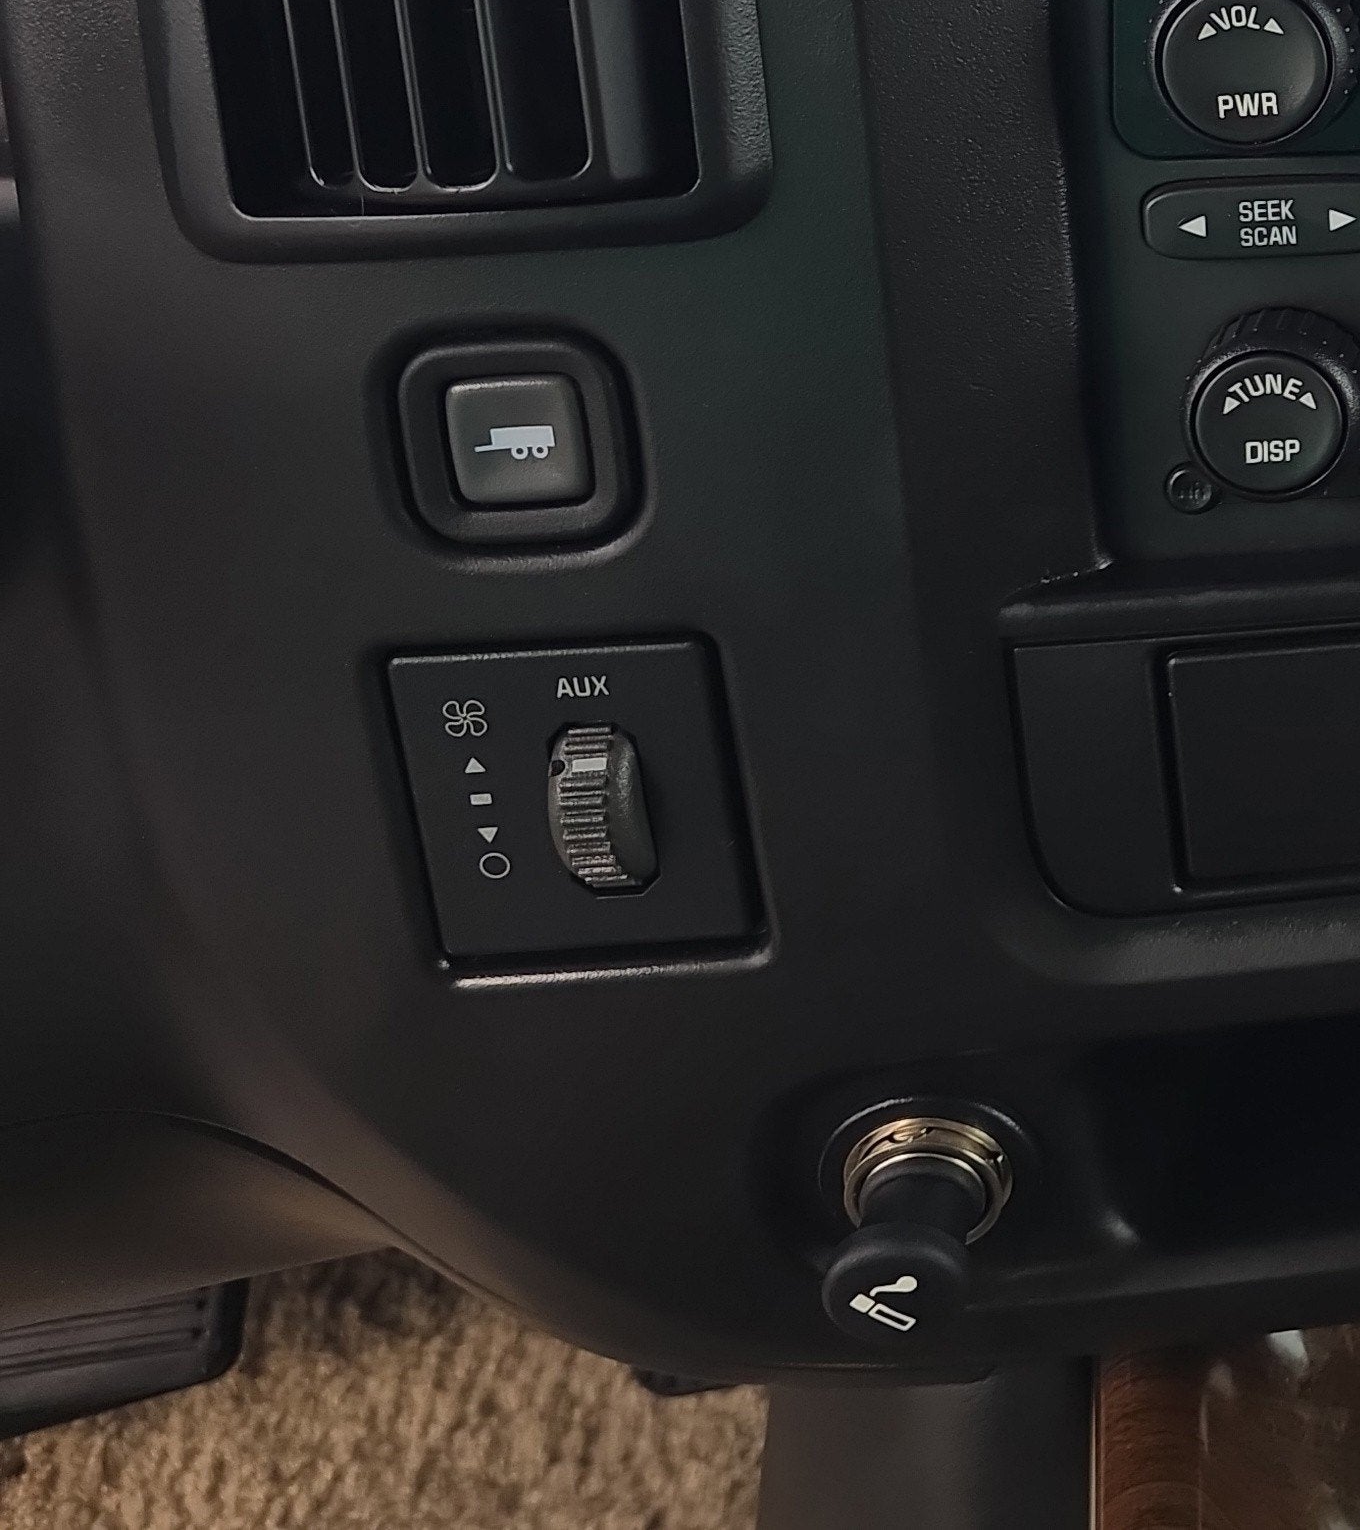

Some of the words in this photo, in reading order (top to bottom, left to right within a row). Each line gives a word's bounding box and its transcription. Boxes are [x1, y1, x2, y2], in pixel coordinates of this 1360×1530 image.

[1208, 5, 1260, 32] VOL
[1217, 92, 1279, 119] PWR
[1238, 199, 1295, 222] SEEK
[1239, 226, 1297, 247] SCAN
[1230, 373, 1304, 406] TUNE
[1245, 439, 1300, 464] DISP
[556, 675, 610, 699] AUX
